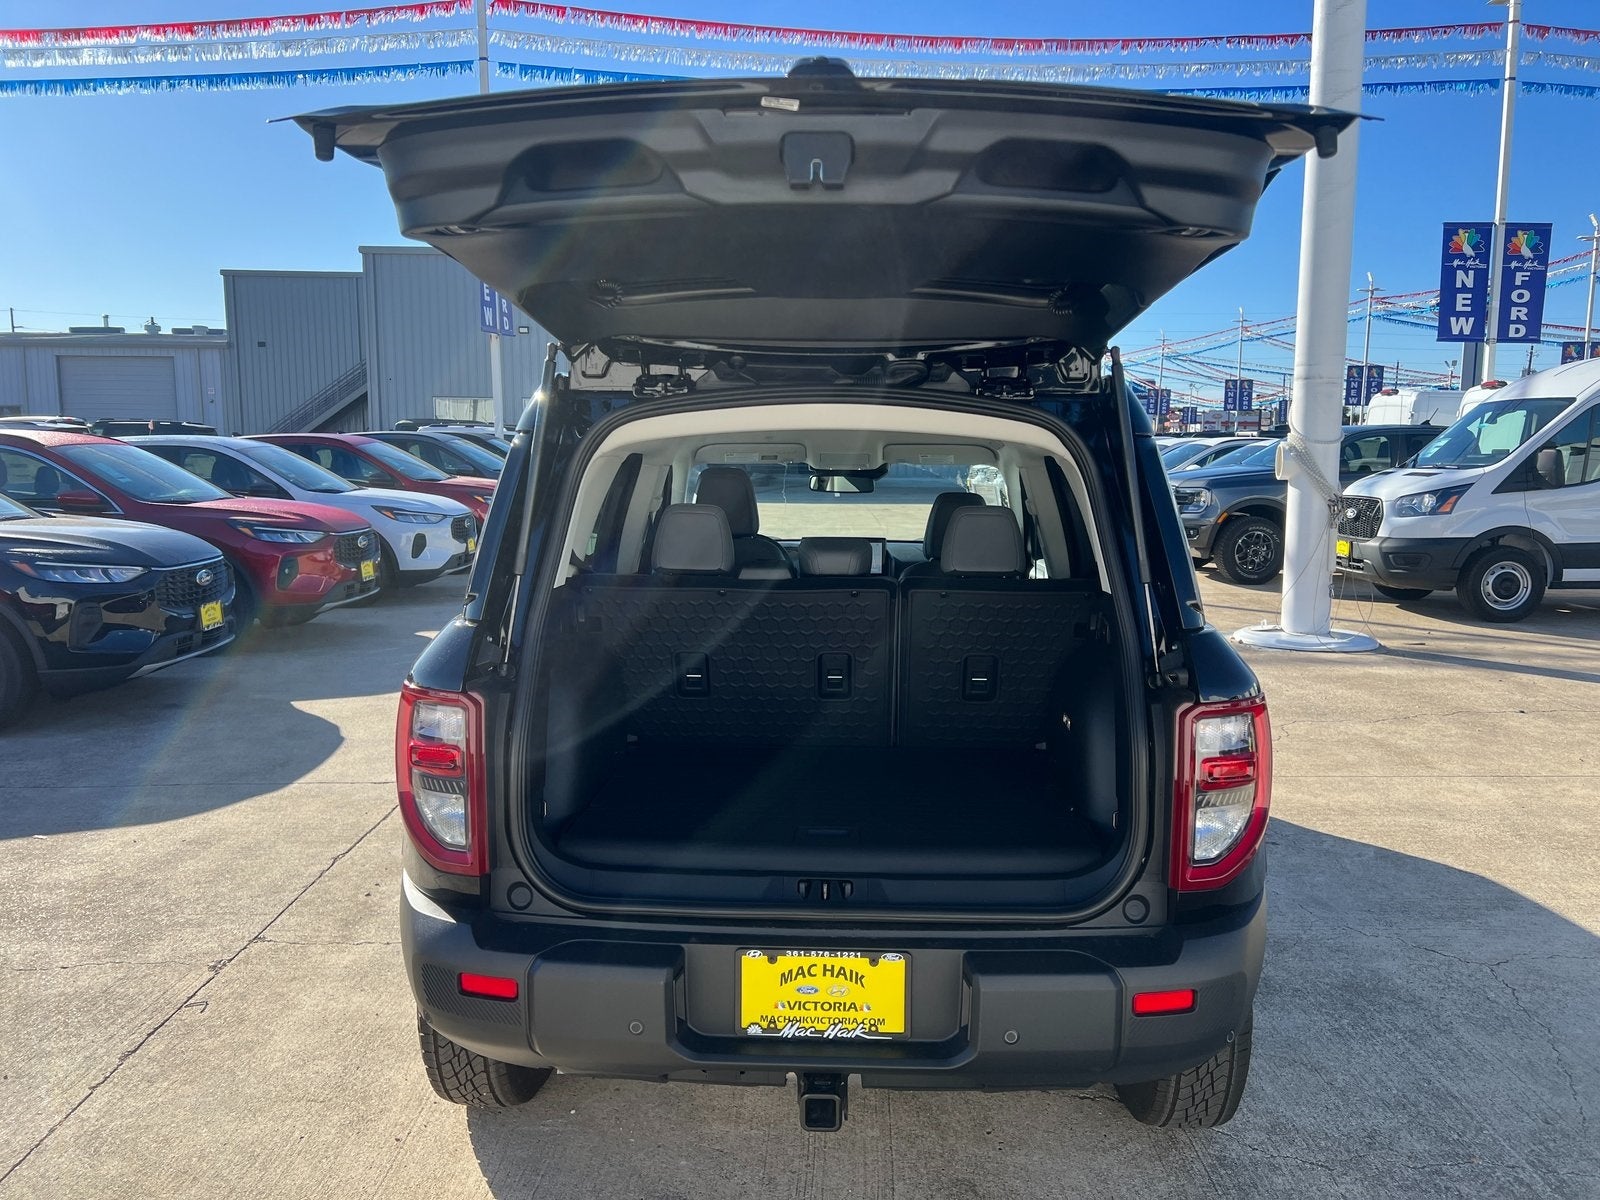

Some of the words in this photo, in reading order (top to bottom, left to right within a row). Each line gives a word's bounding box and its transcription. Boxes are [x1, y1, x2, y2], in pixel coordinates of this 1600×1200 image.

[483, 283, 493, 326] EW
[1450, 270, 1475, 335] NEW
[1508, 272, 1531, 338] FORD
[1227, 391, 1235, 410] NEW
[1349, 381, 1358, 404] NEW
[786, 950, 861, 958] 361-576-1221
[780, 963, 817, 987] MAC
[822, 963, 866, 989] HAIK
[787, 1000, 859, 1012] VICTORIA
[760, 1014, 886, 1026] MACHAIKVICTORIA.COM
[779, 1020, 822, 1038] Mac
[822, 1022, 870, 1040] Haik
